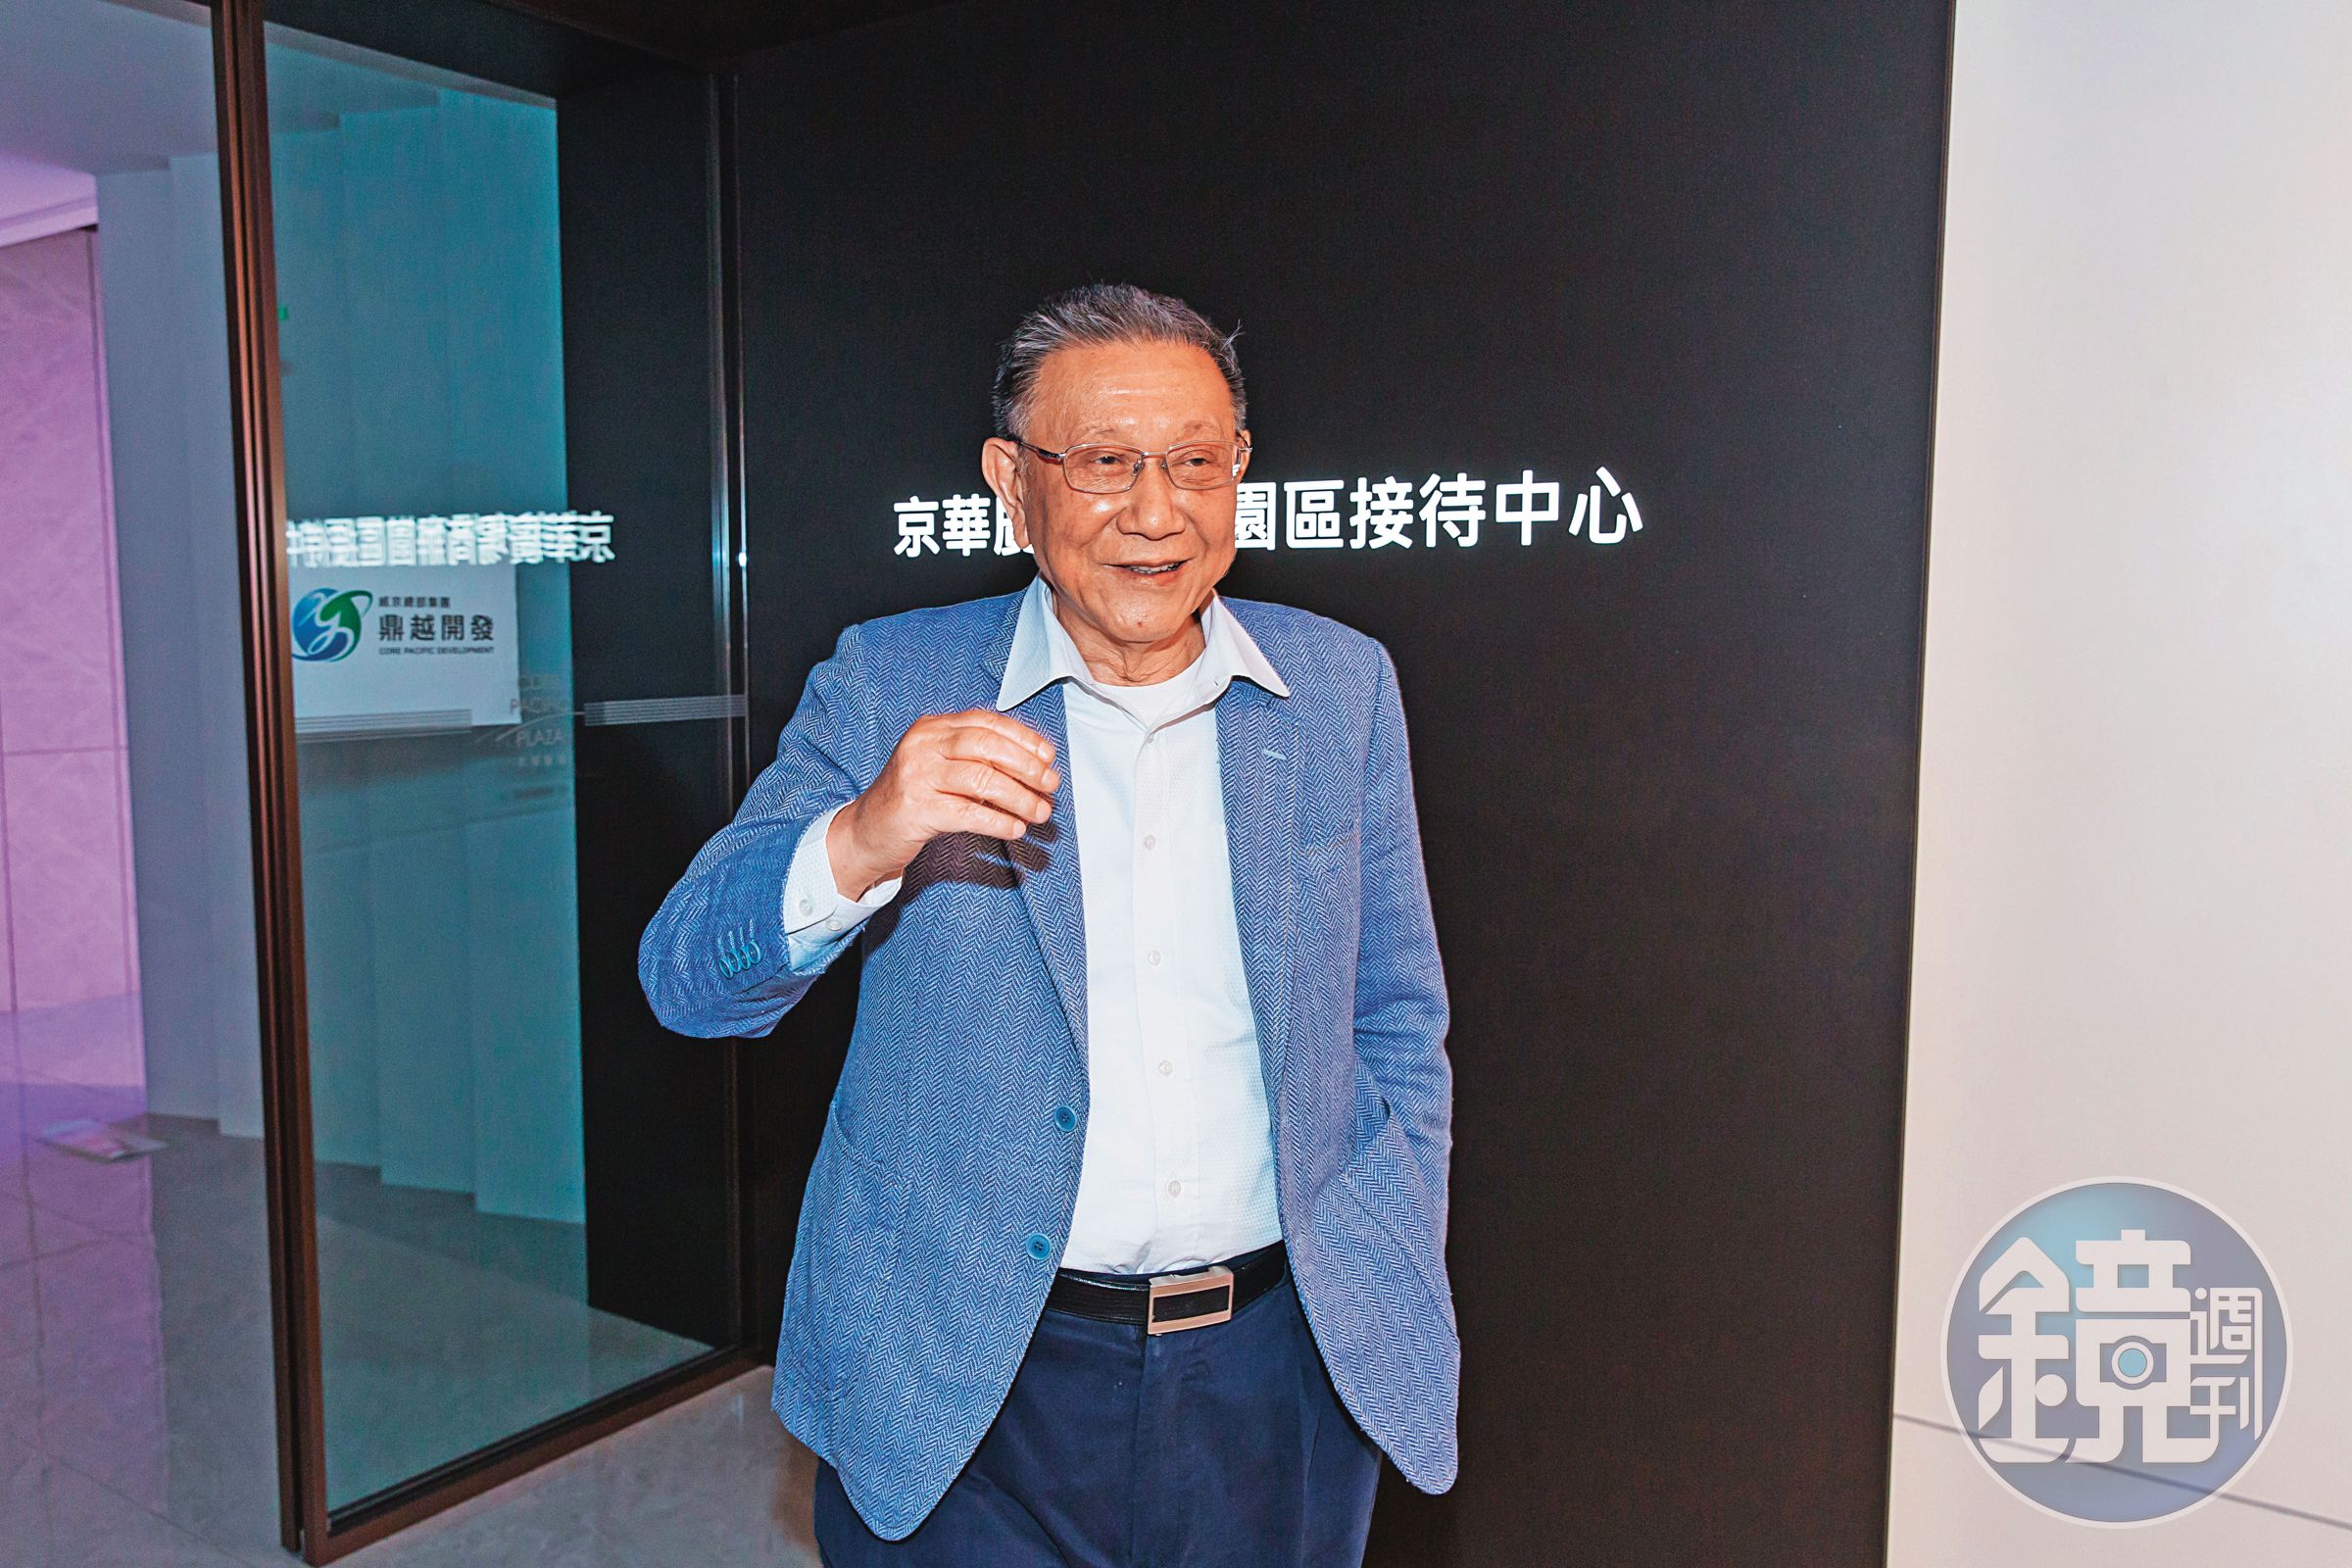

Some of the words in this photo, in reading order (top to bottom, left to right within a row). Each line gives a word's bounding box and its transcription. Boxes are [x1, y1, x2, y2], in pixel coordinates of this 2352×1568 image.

[1235, 466, 1643, 551] 園區接待中心
[378, 613, 494, 642] 鼎越開發
[437, 646, 495, 655] DEVELOPMENT
